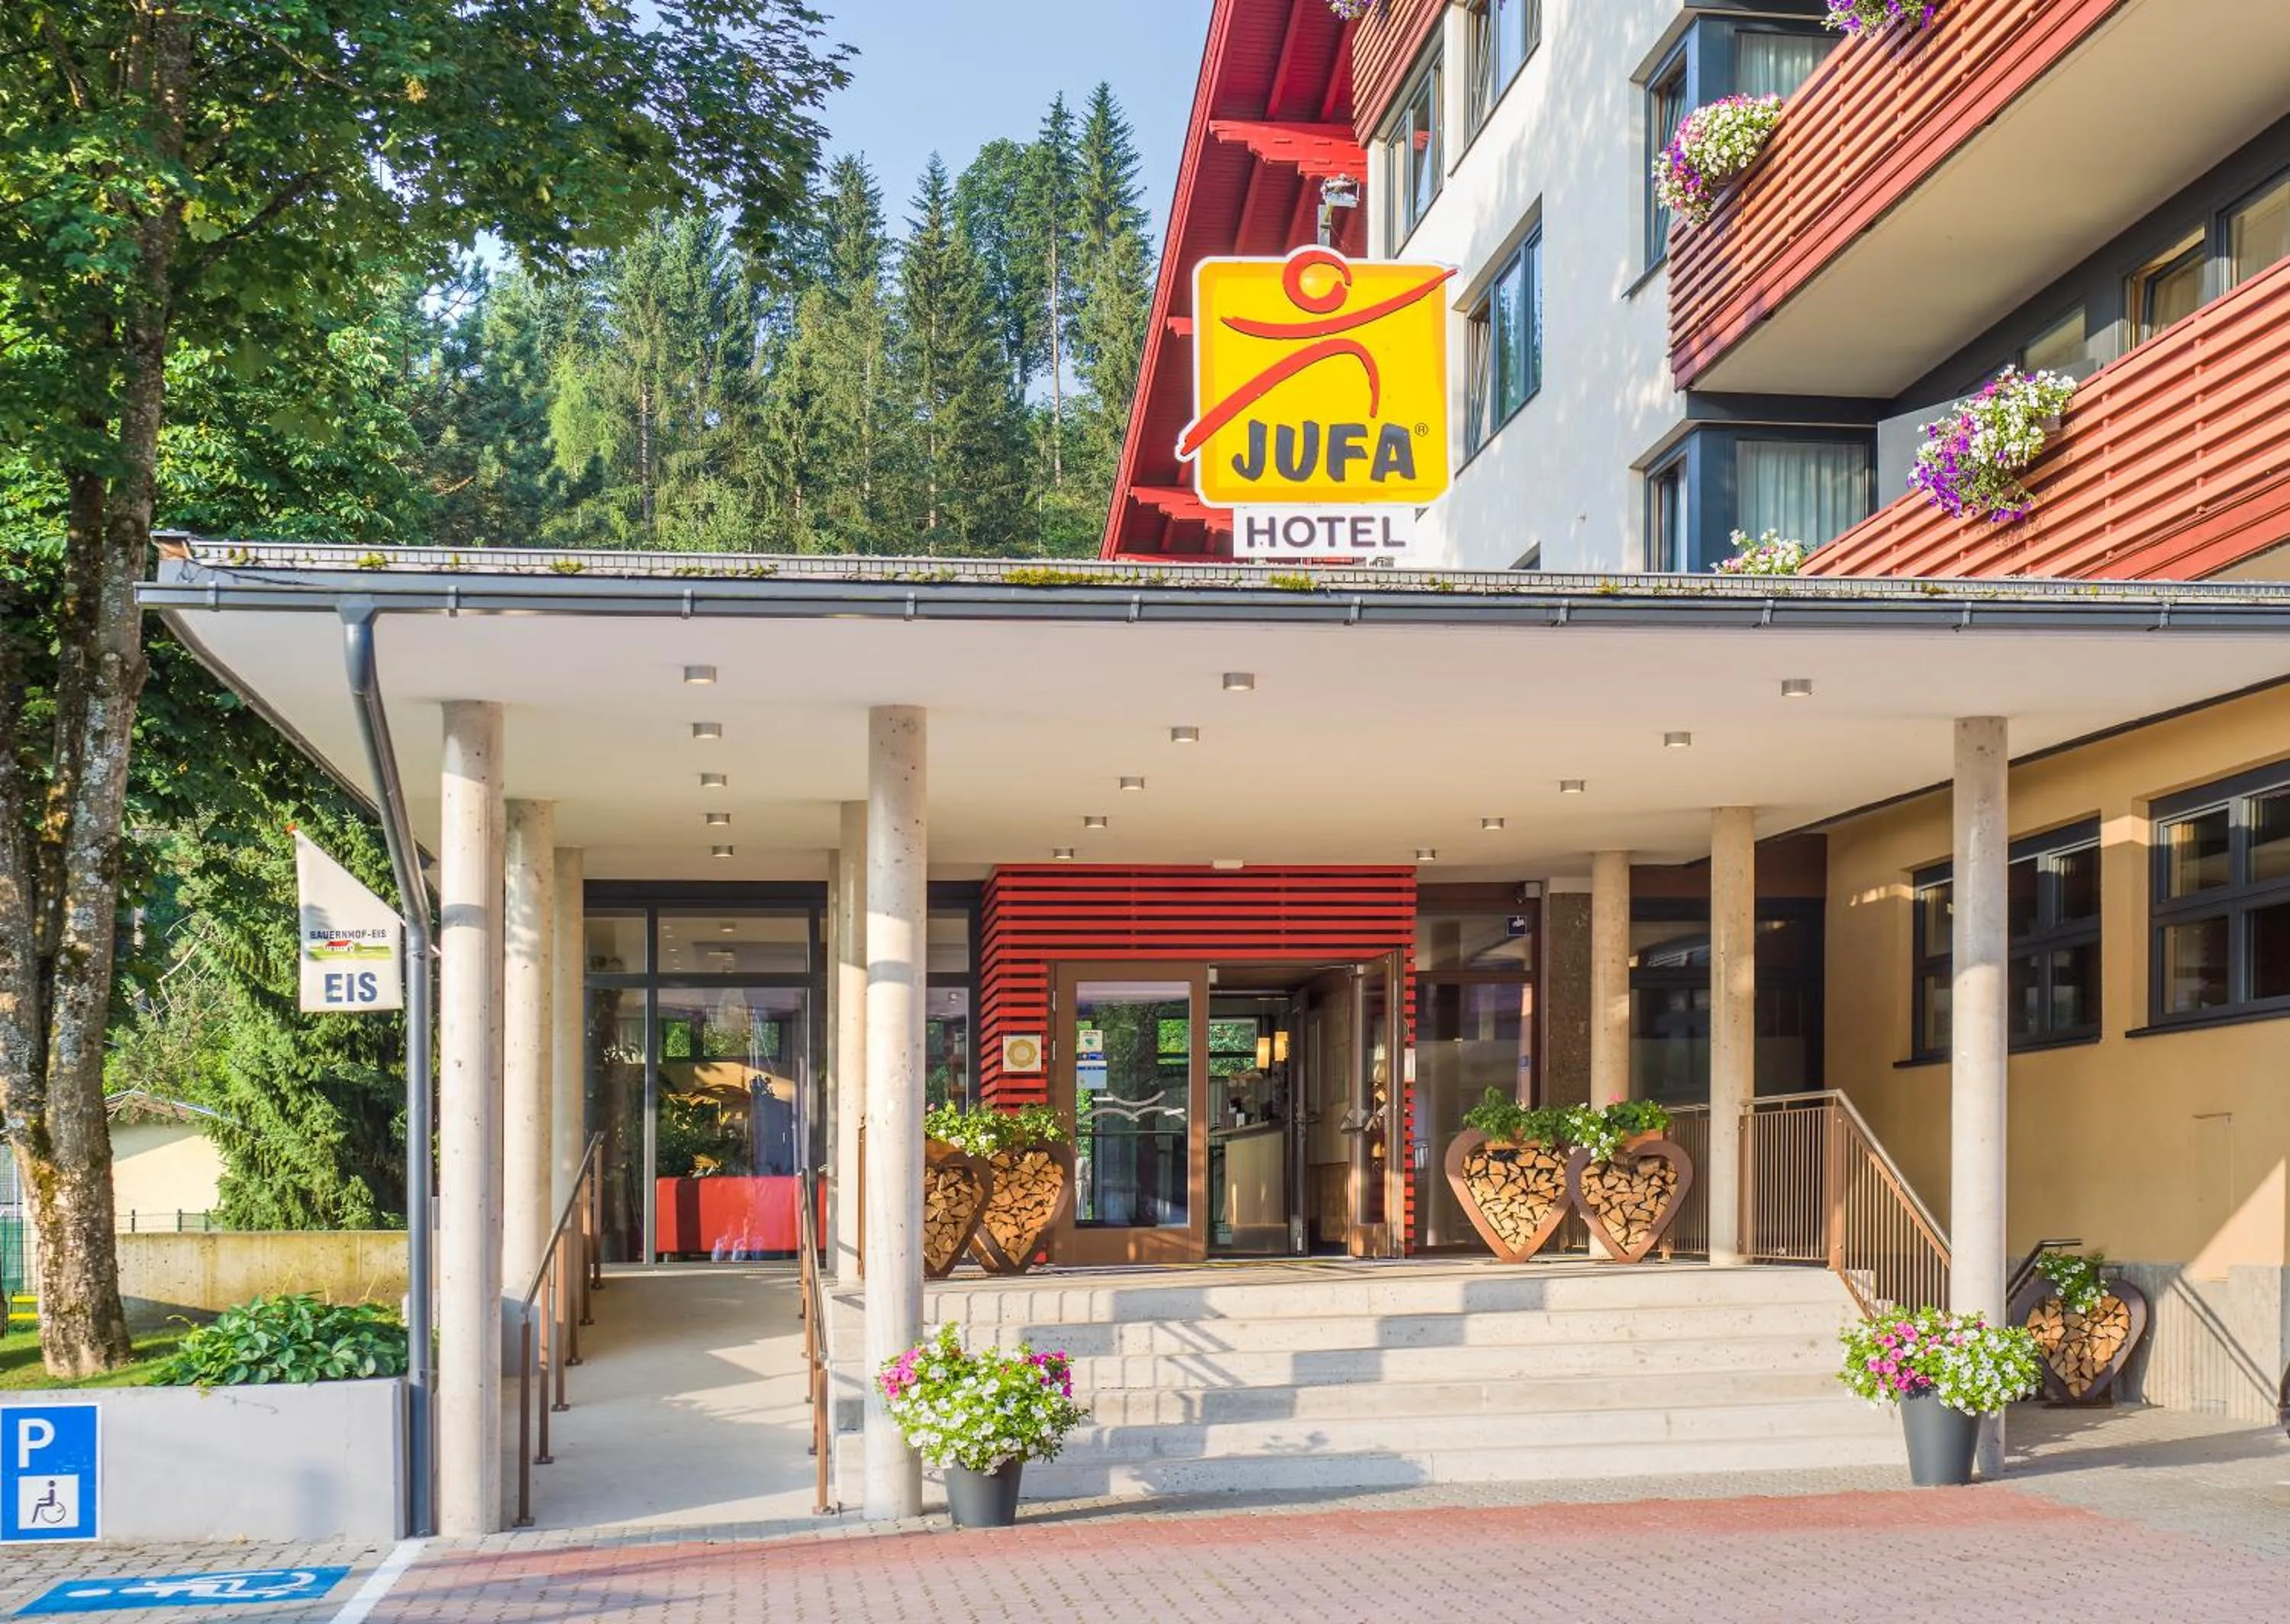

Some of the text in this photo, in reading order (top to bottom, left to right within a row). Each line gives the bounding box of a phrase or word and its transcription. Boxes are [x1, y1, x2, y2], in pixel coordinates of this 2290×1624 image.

[1246, 515, 1405, 549] HOTEL
[309, 929, 387, 939] BAUERNHOF-EIS
[324, 972, 378, 1003] EIS
[18, 1418, 56, 1468] P
